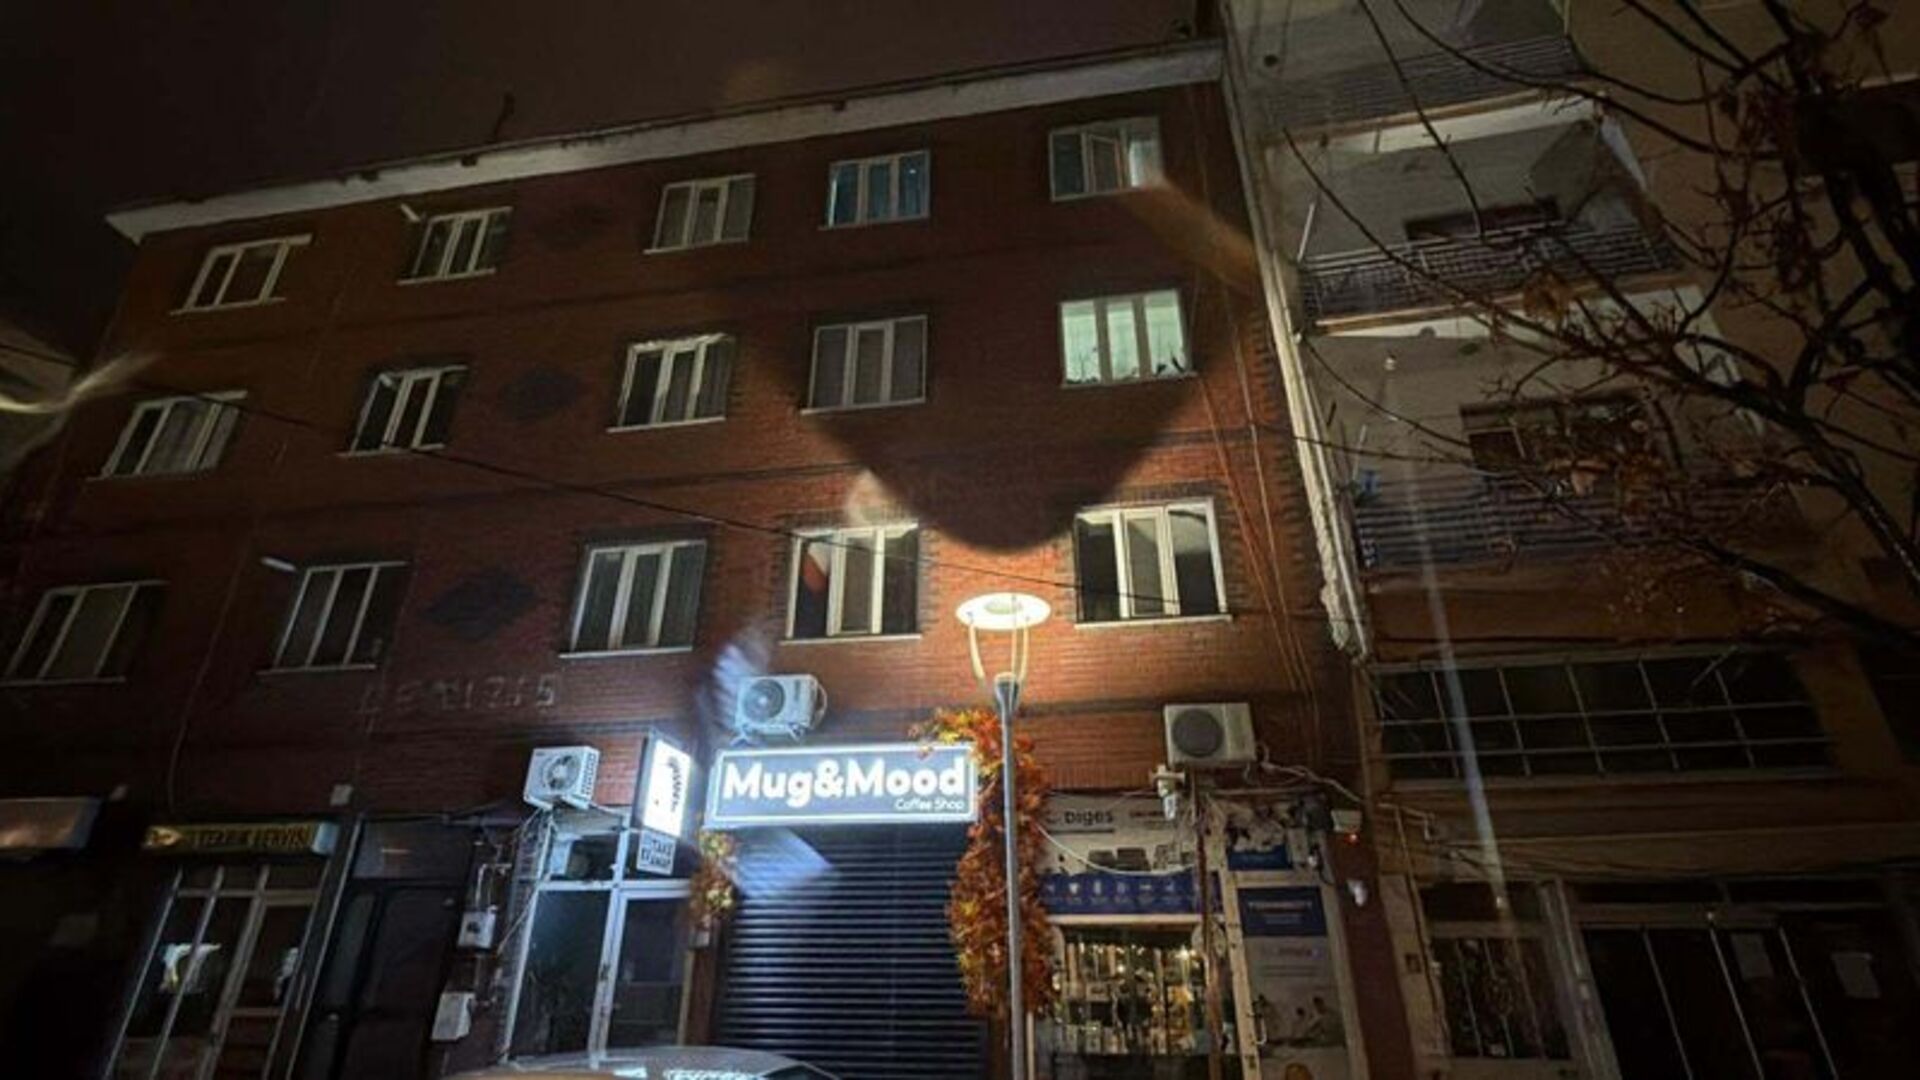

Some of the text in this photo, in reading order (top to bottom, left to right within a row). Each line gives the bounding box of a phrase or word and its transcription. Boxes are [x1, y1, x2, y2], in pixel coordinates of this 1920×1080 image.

[721, 756, 966, 808] Mug&Mood
[894, 797, 966, 812] Coffee Shop
